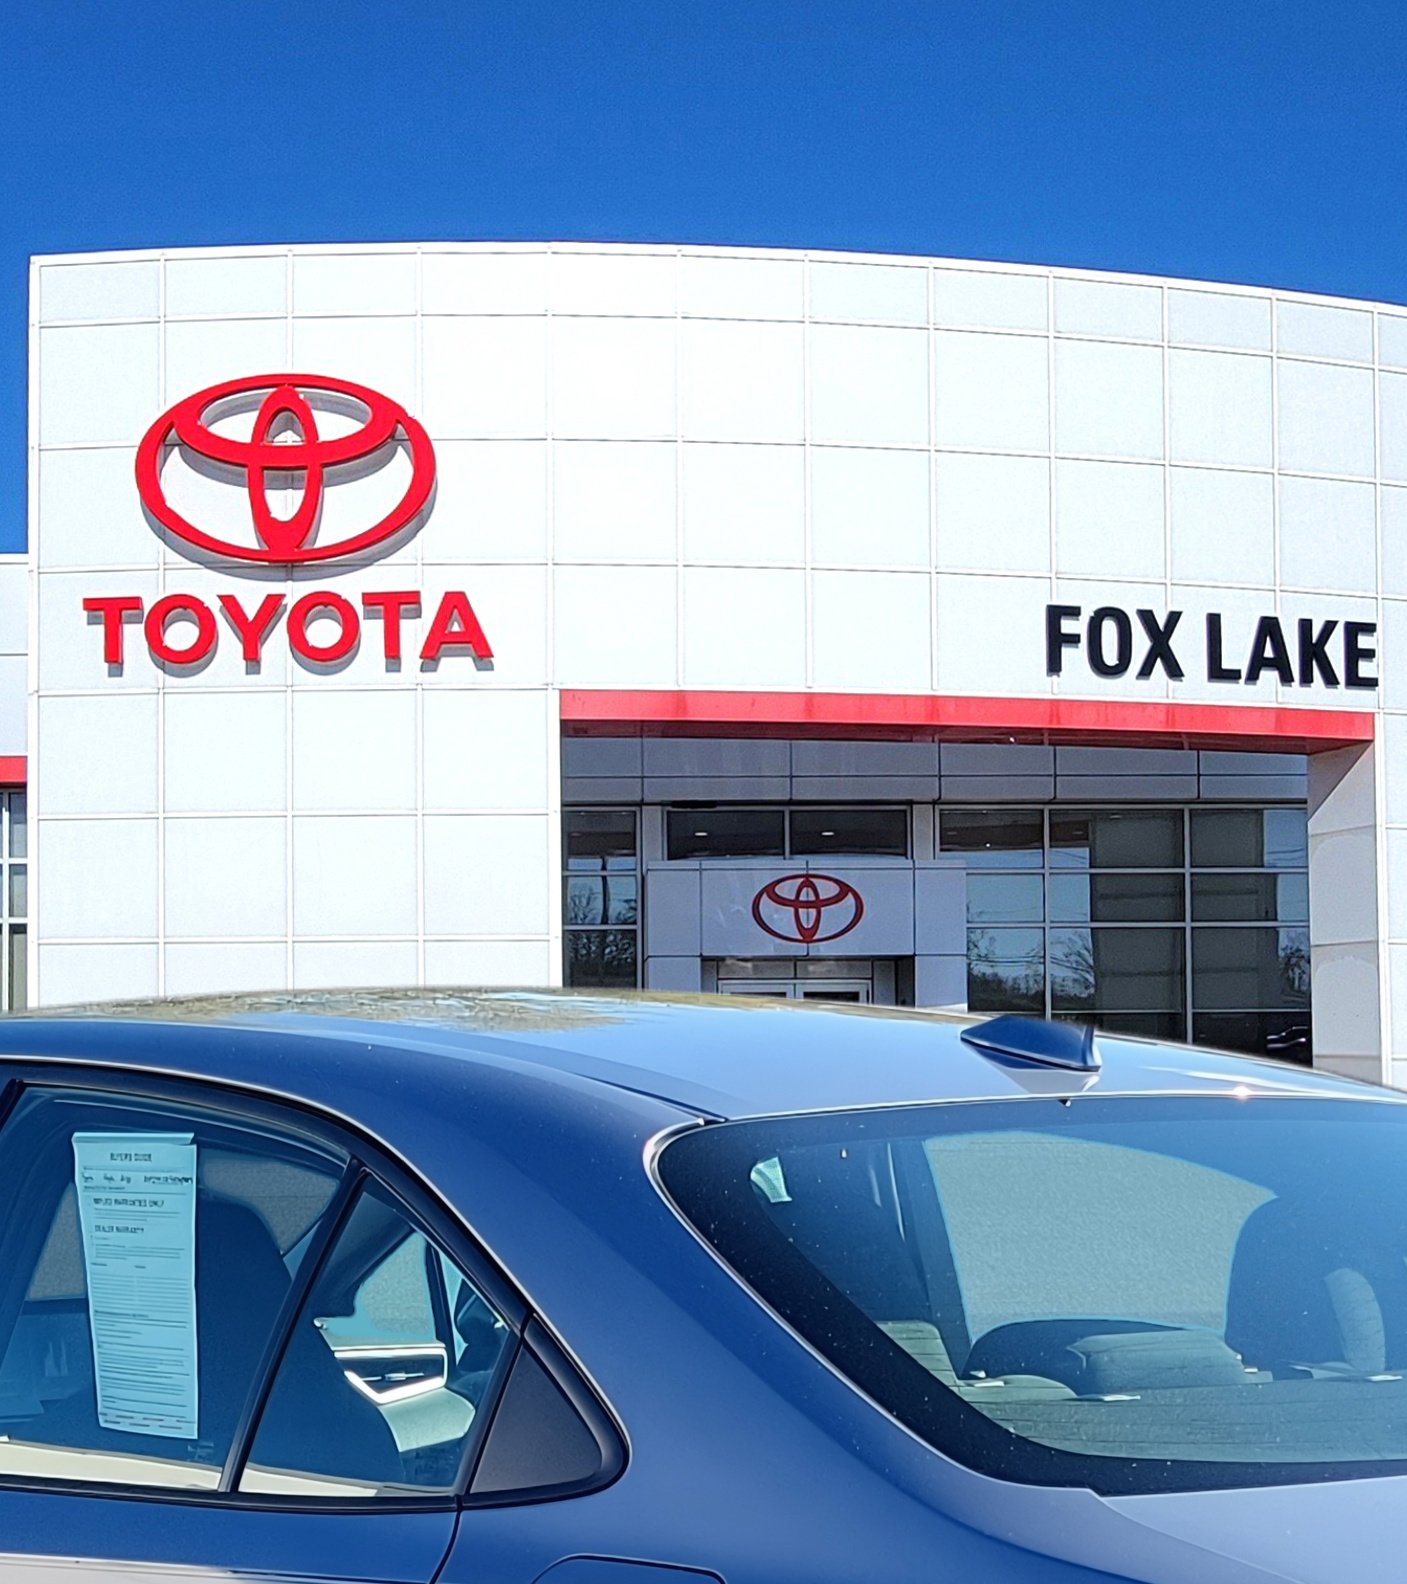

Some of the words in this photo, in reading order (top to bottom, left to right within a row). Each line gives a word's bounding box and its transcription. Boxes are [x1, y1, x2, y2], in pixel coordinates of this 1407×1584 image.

[83, 590, 494, 672] TOYOTA
[1046, 604, 1185, 681] FOX
[1206, 612, 1380, 689] LAKE
